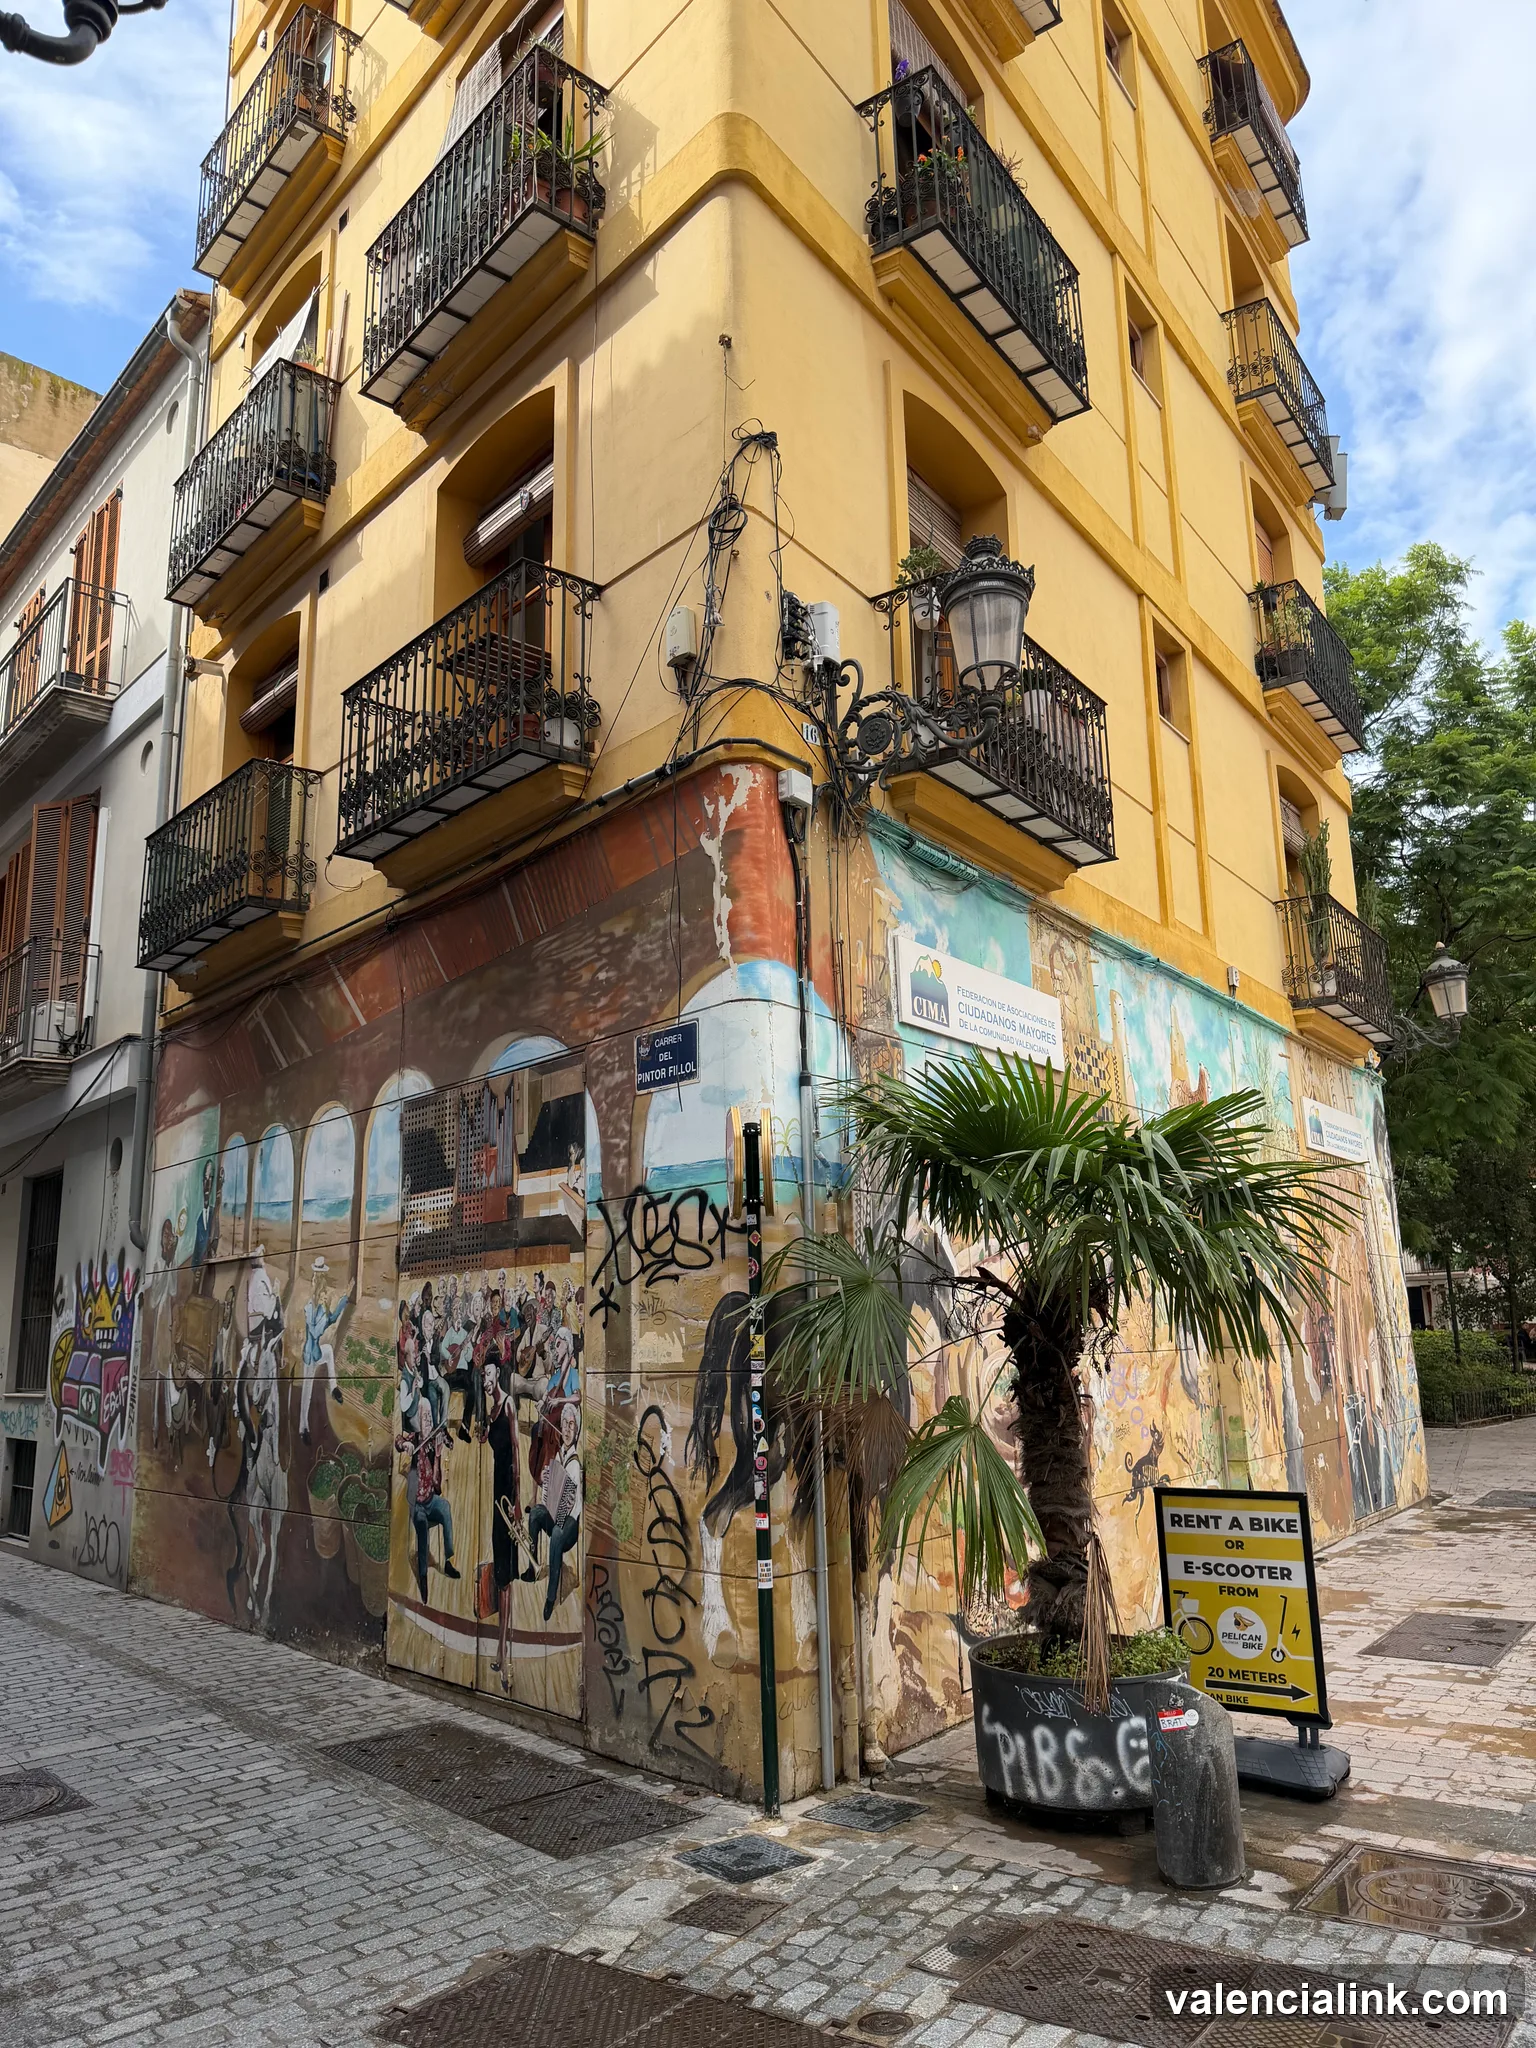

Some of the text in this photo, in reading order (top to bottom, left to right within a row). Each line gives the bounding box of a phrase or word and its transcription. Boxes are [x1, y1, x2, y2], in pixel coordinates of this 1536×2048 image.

[805, 725, 817, 743] 16
[913, 996, 948, 1025] CIMA
[958, 1001, 1057, 1046] CIUDADANOS MAYORES
[959, 1018, 969, 1030] DE
[969, 1022, 979, 1033] LA
[979, 1026, 1015, 1045] COMUNIDAD
[654, 1033, 682, 1048] CARRER
[658, 1051, 673, 1062] DEL
[637, 1061, 697, 1085] PINTOR FILLOL
[1170, 1513, 1299, 1534] RENT A BIKE
[1224, 1539, 1245, 1550] OR
[1183, 1561, 1293, 1581] E-SCOOTER
[1218, 1585, 1259, 1598] FROM
[1221, 1631, 1262, 1642] PELICAN
[1242, 1642, 1263, 1651] BIKE
[1207, 1666, 1287, 1685] 20 METERS
[1225, 1694, 1250, 1705] BIKE
[1160, 1717, 1183, 1728] BRAT
